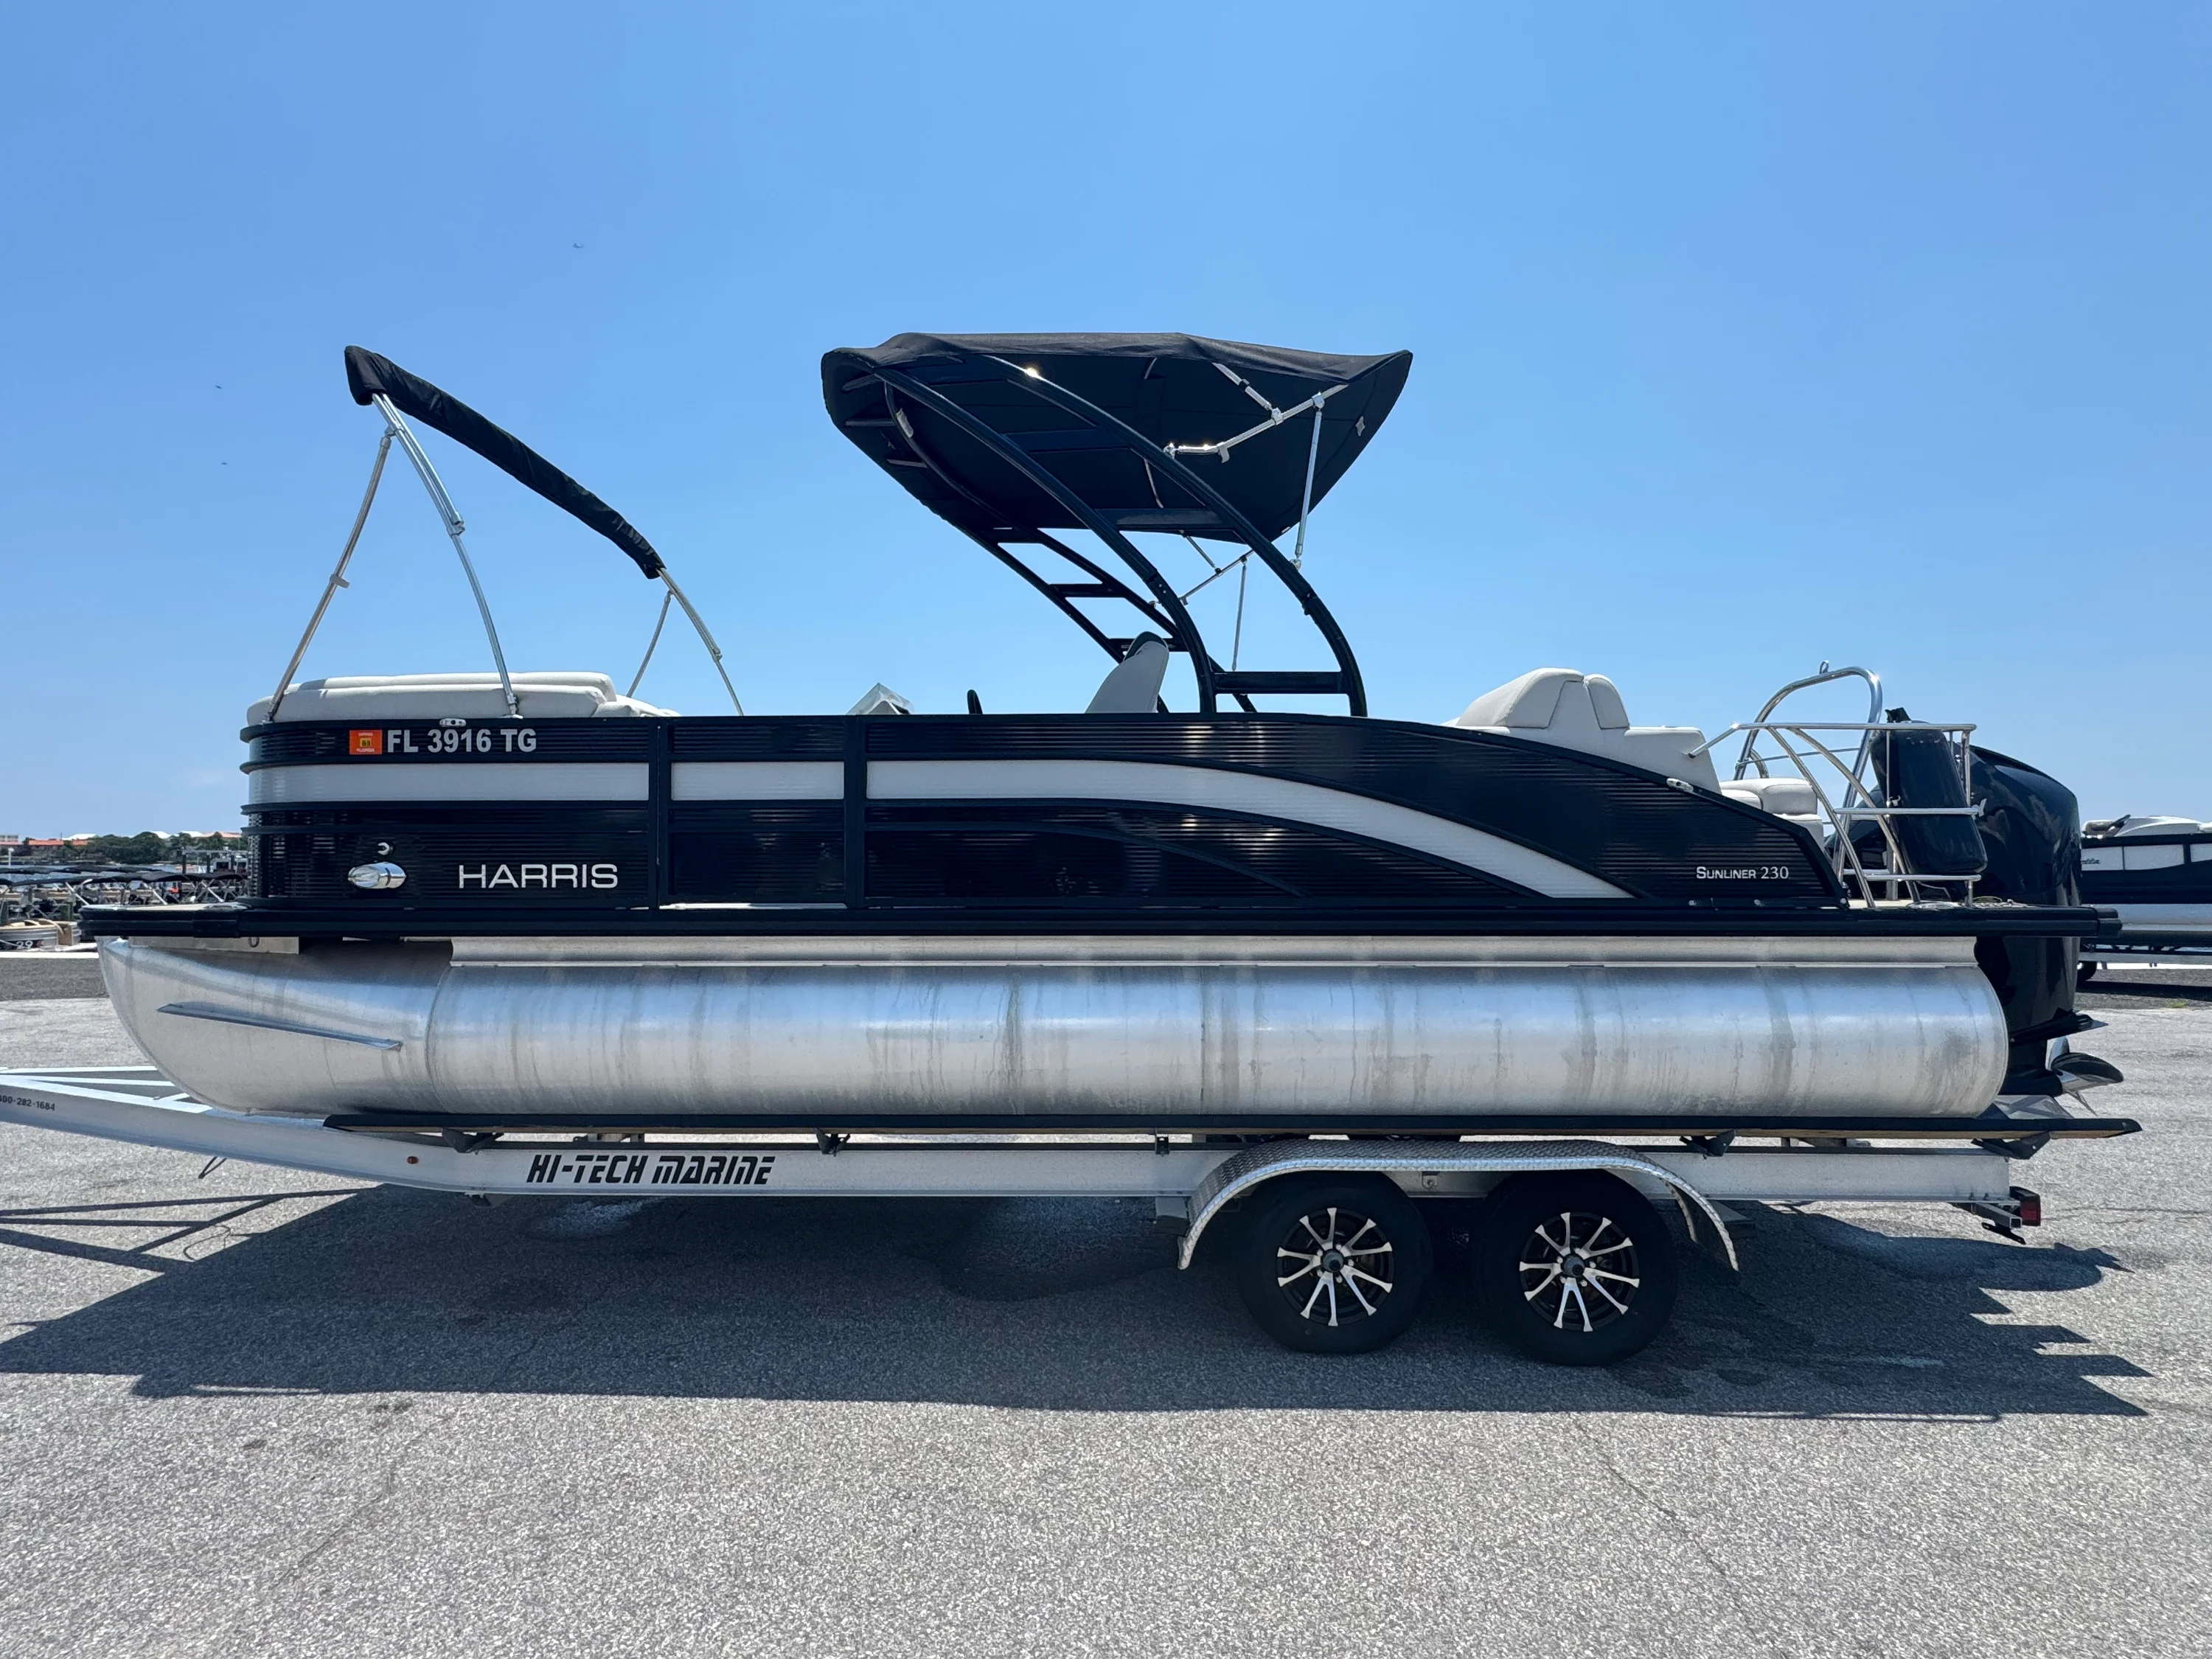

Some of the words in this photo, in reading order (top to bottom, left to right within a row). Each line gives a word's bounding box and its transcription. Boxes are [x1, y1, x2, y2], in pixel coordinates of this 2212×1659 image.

[387, 729, 419, 753] FL
[427, 728, 492, 754] 3916
[500, 728, 537, 754] TG
[458, 863, 619, 888] HARRIS
[1760, 866, 1790, 880] 230
[526, 1155, 649, 1184] HI-TECH
[651, 1155, 776, 1185] MARINE
